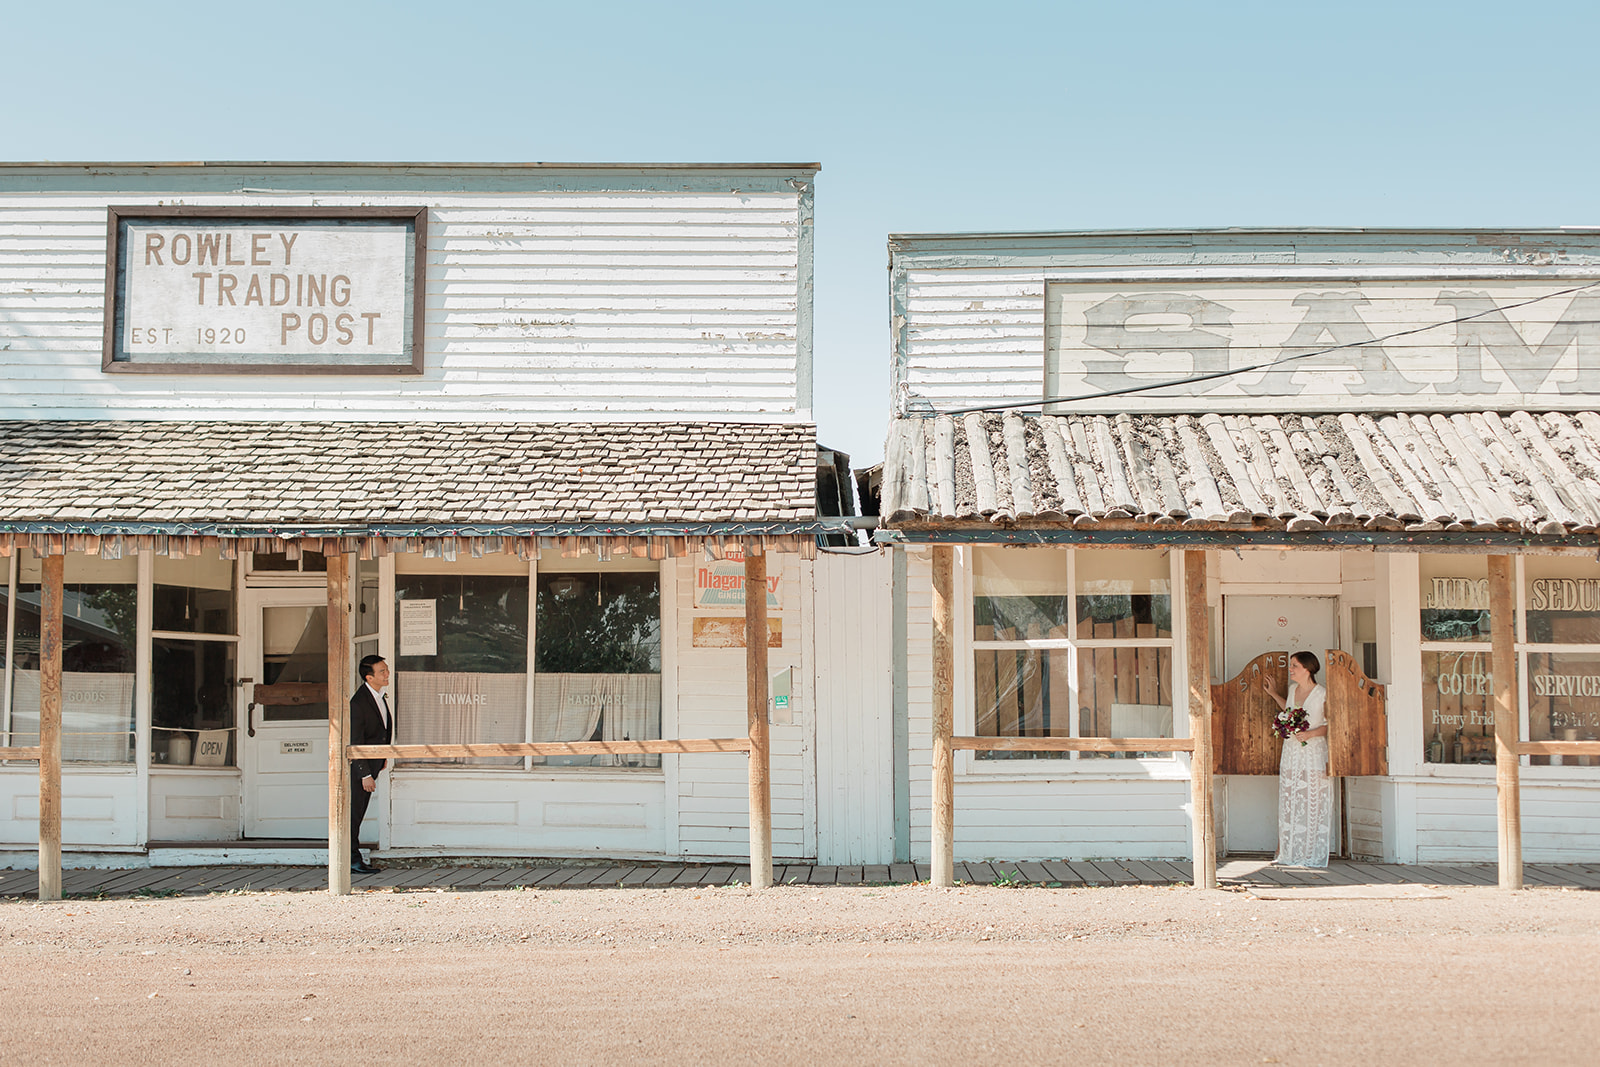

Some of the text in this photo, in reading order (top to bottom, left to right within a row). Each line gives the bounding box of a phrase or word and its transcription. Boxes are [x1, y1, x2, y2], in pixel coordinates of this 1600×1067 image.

[144, 232, 299, 267] ROWLEY
[191, 272, 352, 307] TRADING
[131, 327, 247, 345] EST. 1920
[280, 312, 382, 346] POST
[698, 568, 746, 591] Niagar
[1426, 577, 1600, 612] JUDG SEDU
[68, 690, 106, 703] GOODS
[437, 693, 488, 705] TINWARE
[567, 694, 629, 706] HARDWARE
[1431, 709, 1468, 730] Every
[1470, 710, 1495, 726] Frid
[200, 741, 223, 755] OPEN
